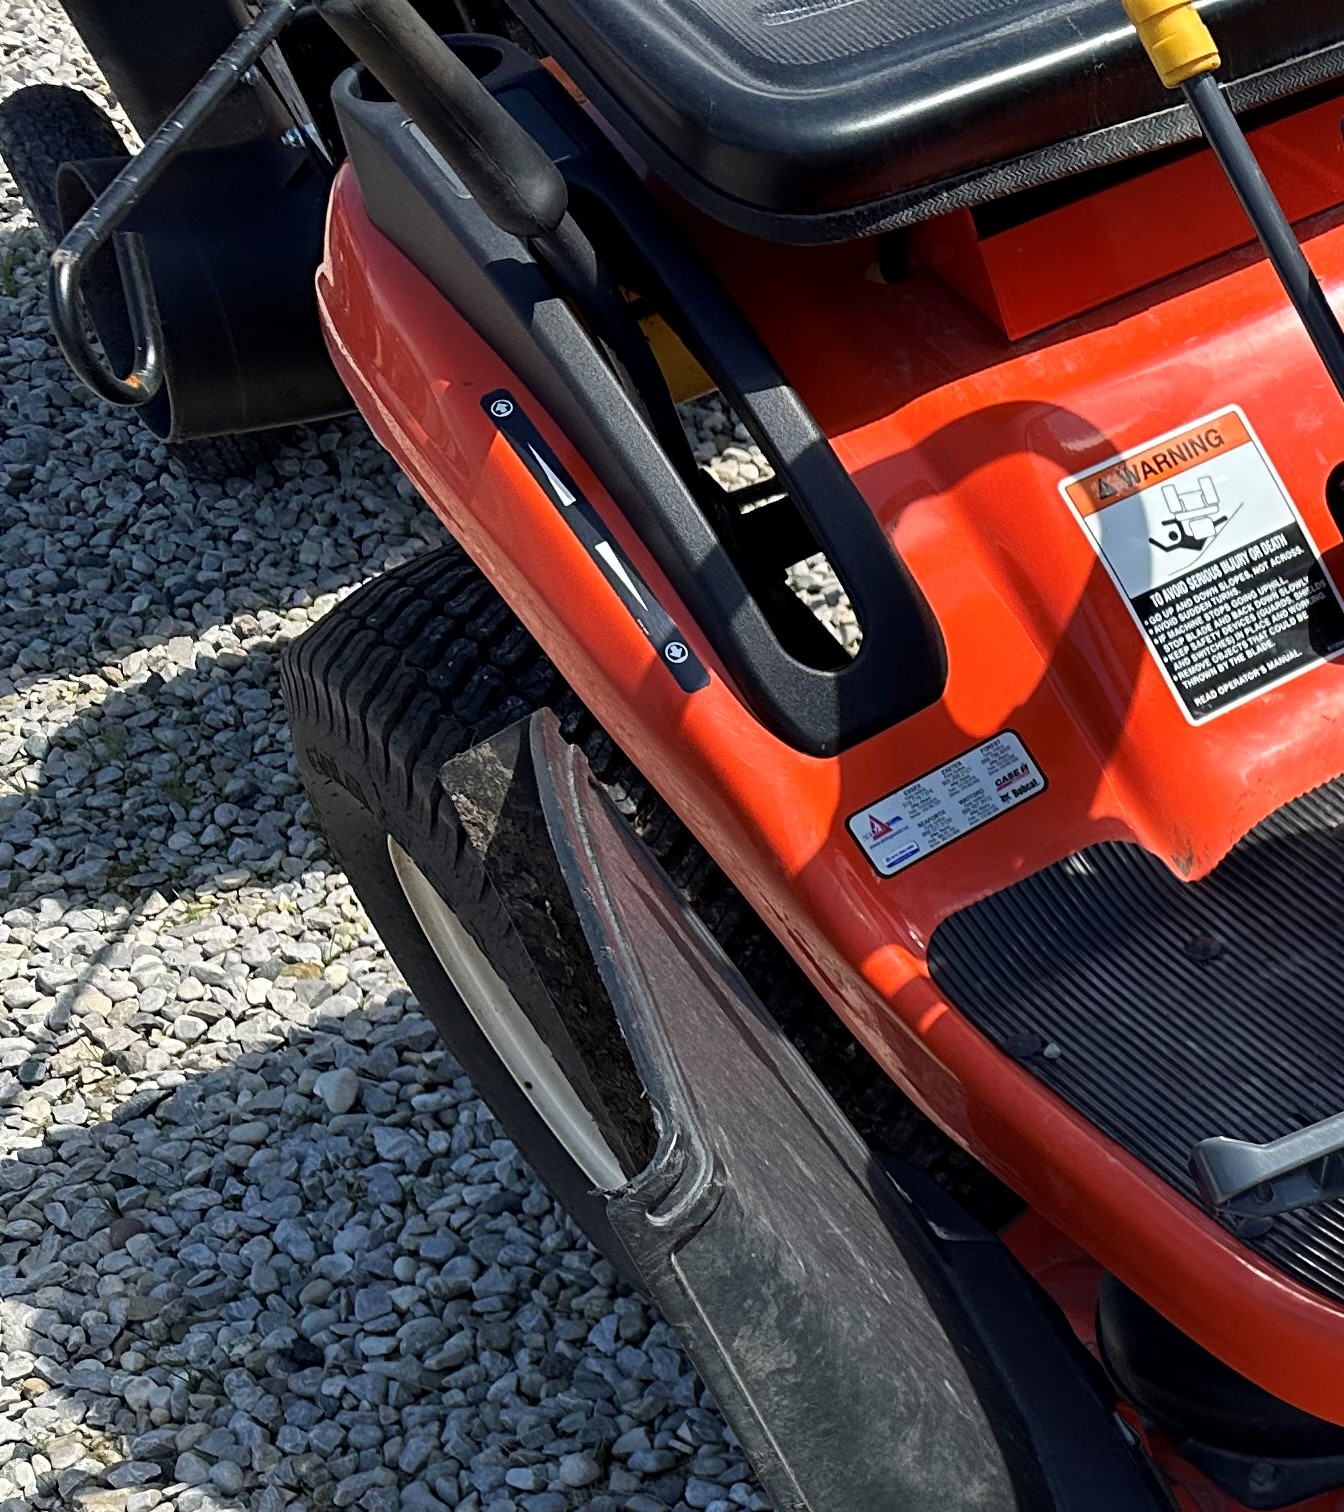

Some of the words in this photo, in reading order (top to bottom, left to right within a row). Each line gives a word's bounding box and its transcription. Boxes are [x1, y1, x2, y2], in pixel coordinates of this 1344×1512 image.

[1119, 427, 1225, 487] WARNING
[1147, 612, 1163, 625] GO
[1160, 605, 1176, 618] UP
[1173, 596, 1194, 612] AND
[1191, 584, 1219, 603] DOWN
[1250, 560, 1270, 575] NOT
[1267, 543, 1305, 567] ACROSS.
[1148, 591, 1165, 608] TO
[1159, 579, 1190, 602] AVOID
[1184, 563, 1223, 590] SERIOUS
[1217, 549, 1252, 574] INJURY
[1246, 544, 1263, 561] OR
[1258, 531, 1289, 555] DEATH
[1152, 616, 1179, 634] AVOID
[1176, 599, 1213, 622] SUDDEN
[1209, 585, 1241, 606] TURNS.
[1156, 633, 1168, 643] IF
[1165, 615, 1205, 639] MACHINE
[1202, 602, 1231, 622] STOPS
[1229, 588, 1258, 608] GOING
[1161, 635, 1187, 653] STOP
[1183, 622, 1214, 642] BLADE
[1211, 613, 1232, 629] AND
[1229, 602, 1255, 620] BACK
[1252, 590, 1280, 609] DOWN
[1166, 644, 1192, 662] KEEP
[1189, 629, 1223, 651] SAFETY
[1220, 612, 1258, 636] DEVICES
[1171, 655, 1192, 671] AND
[1233, 629, 1245, 641] IN
[1242, 616, 1272, 636] PLACE
[1269, 607, 1289, 623] AND
[1176, 657, 1212, 680] REMOVE
[1209, 638, 1250, 664] OBJECTS
[1246, 628, 1270, 646] THAT
[1266, 615, 1298, 636] COULD
[1294, 609, 1310, 623] BE
[1181, 666, 1219, 689] THROWN
[1215, 660, 1230, 673] BY
[1227, 651, 1247, 667] THE
[1192, 688, 1219, 707] READ
[1215, 663, 1268, 695] OPERATOR'S
[1264, 645, 1304, 671] MANUAL.
[1010, 776, 1039, 798] Bobcat
